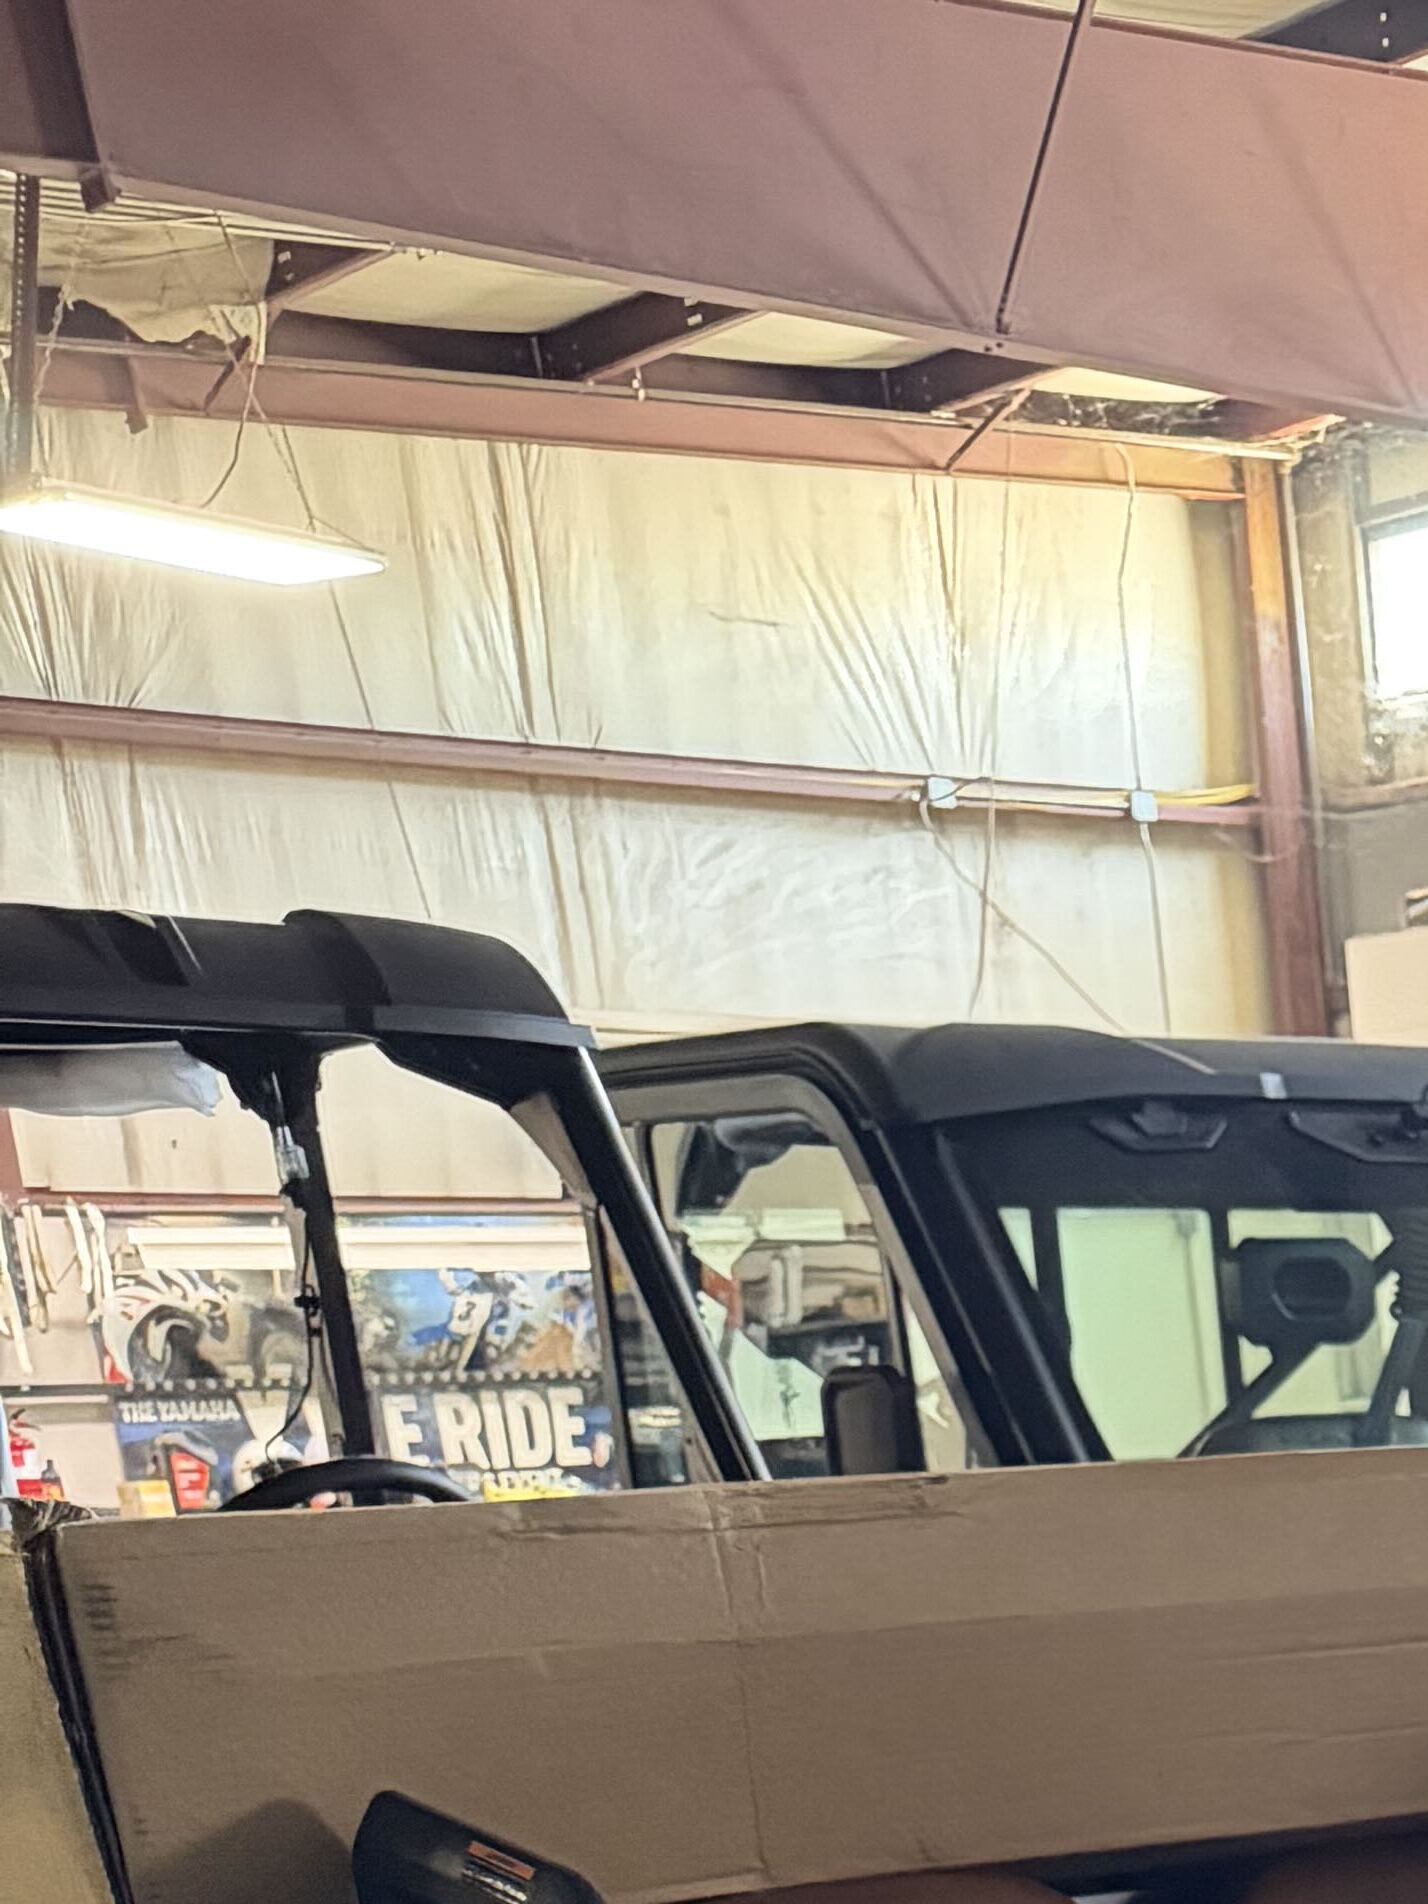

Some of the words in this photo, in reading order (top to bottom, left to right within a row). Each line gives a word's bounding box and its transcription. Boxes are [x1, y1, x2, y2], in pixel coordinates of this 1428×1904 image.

[118, 1400, 158, 1424] THE
[158, 1398, 242, 1423] YAMAHA
[380, 1393, 431, 1467] E
[433, 1386, 593, 1470] RIDE
